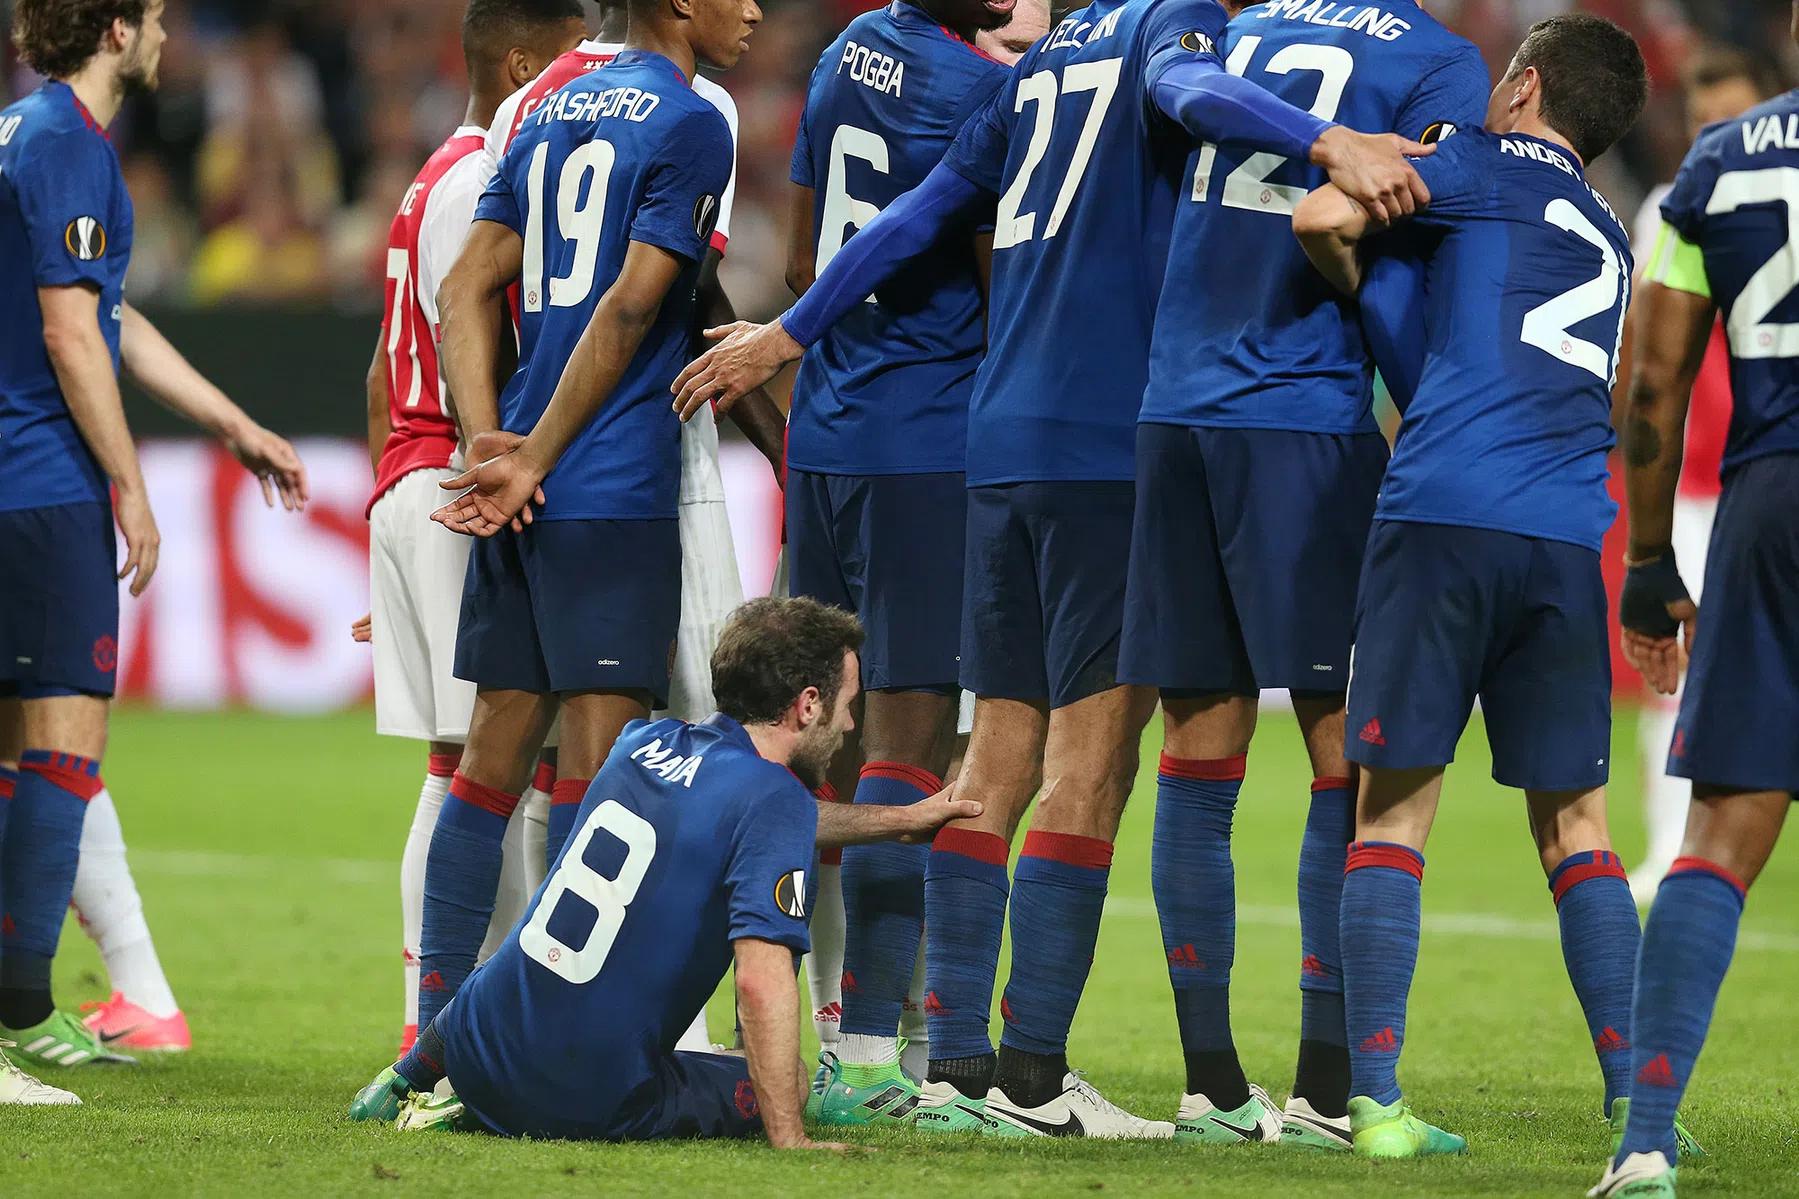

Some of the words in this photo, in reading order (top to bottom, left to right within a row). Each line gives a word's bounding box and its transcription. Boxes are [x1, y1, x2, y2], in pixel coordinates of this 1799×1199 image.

[536, 87, 661, 126] RASHFORD
[837, 40, 904, 98] POGBA
[1256, 0, 1412, 42] SMALLING
[523, 139, 616, 313] 19
[815, 124, 889, 303] 6
[993, 57, 1123, 250] 27
[518, 799, 657, 985] 8
